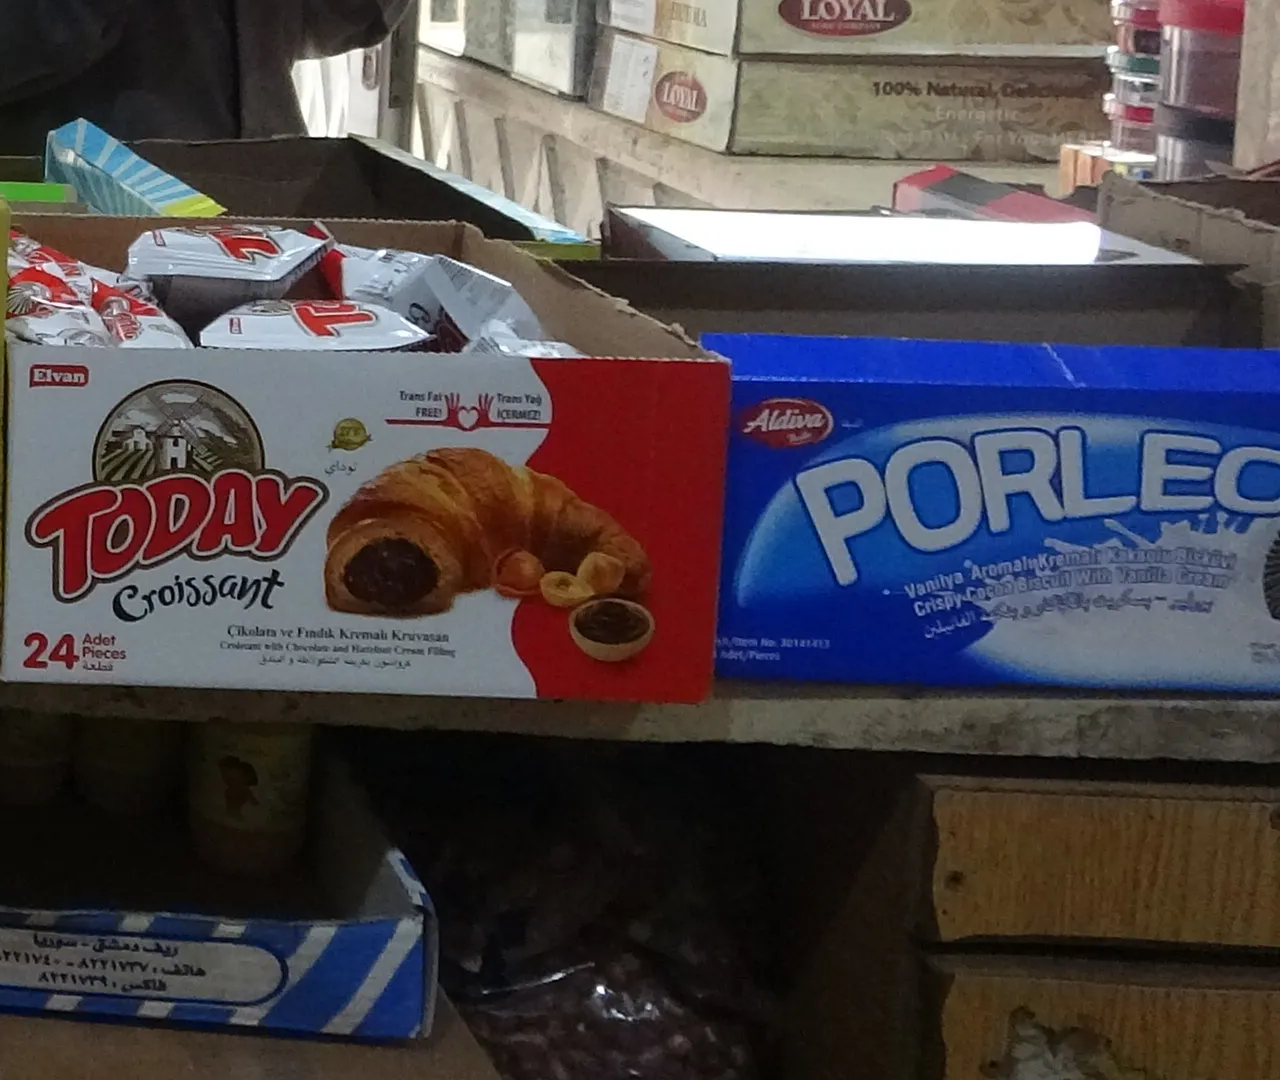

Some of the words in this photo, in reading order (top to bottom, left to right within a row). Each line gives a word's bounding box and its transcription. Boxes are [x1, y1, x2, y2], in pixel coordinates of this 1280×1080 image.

[663, 82, 700, 111] LOYAL
[872, 81, 922, 97] 100%
[32, 368, 87, 384] Elvan
[399, 391, 426, 402] Trans
[496, 393, 523, 404] Trans
[743, 408, 826, 433] Aldiva
[31, 468, 325, 601] TODAY
[904, 571, 965, 599] Vanilya
[112, 567, 285, 622] Croissant
[913, 593, 963, 618] Crispy
[82, 633, 117, 646] Adet
[227, 624, 278, 639] Çikolata
[280, 628, 295, 638] ve
[392, 629, 450, 642] Kruvasan
[22, 631, 81, 670] 24
[82, 646, 128, 660] Pieces
[331, 644, 348, 653] and
[32, 933, 78, 951] سوريا
[92, 937, 140, 954] دمشق
[142, 941, 180, 959] ريف
